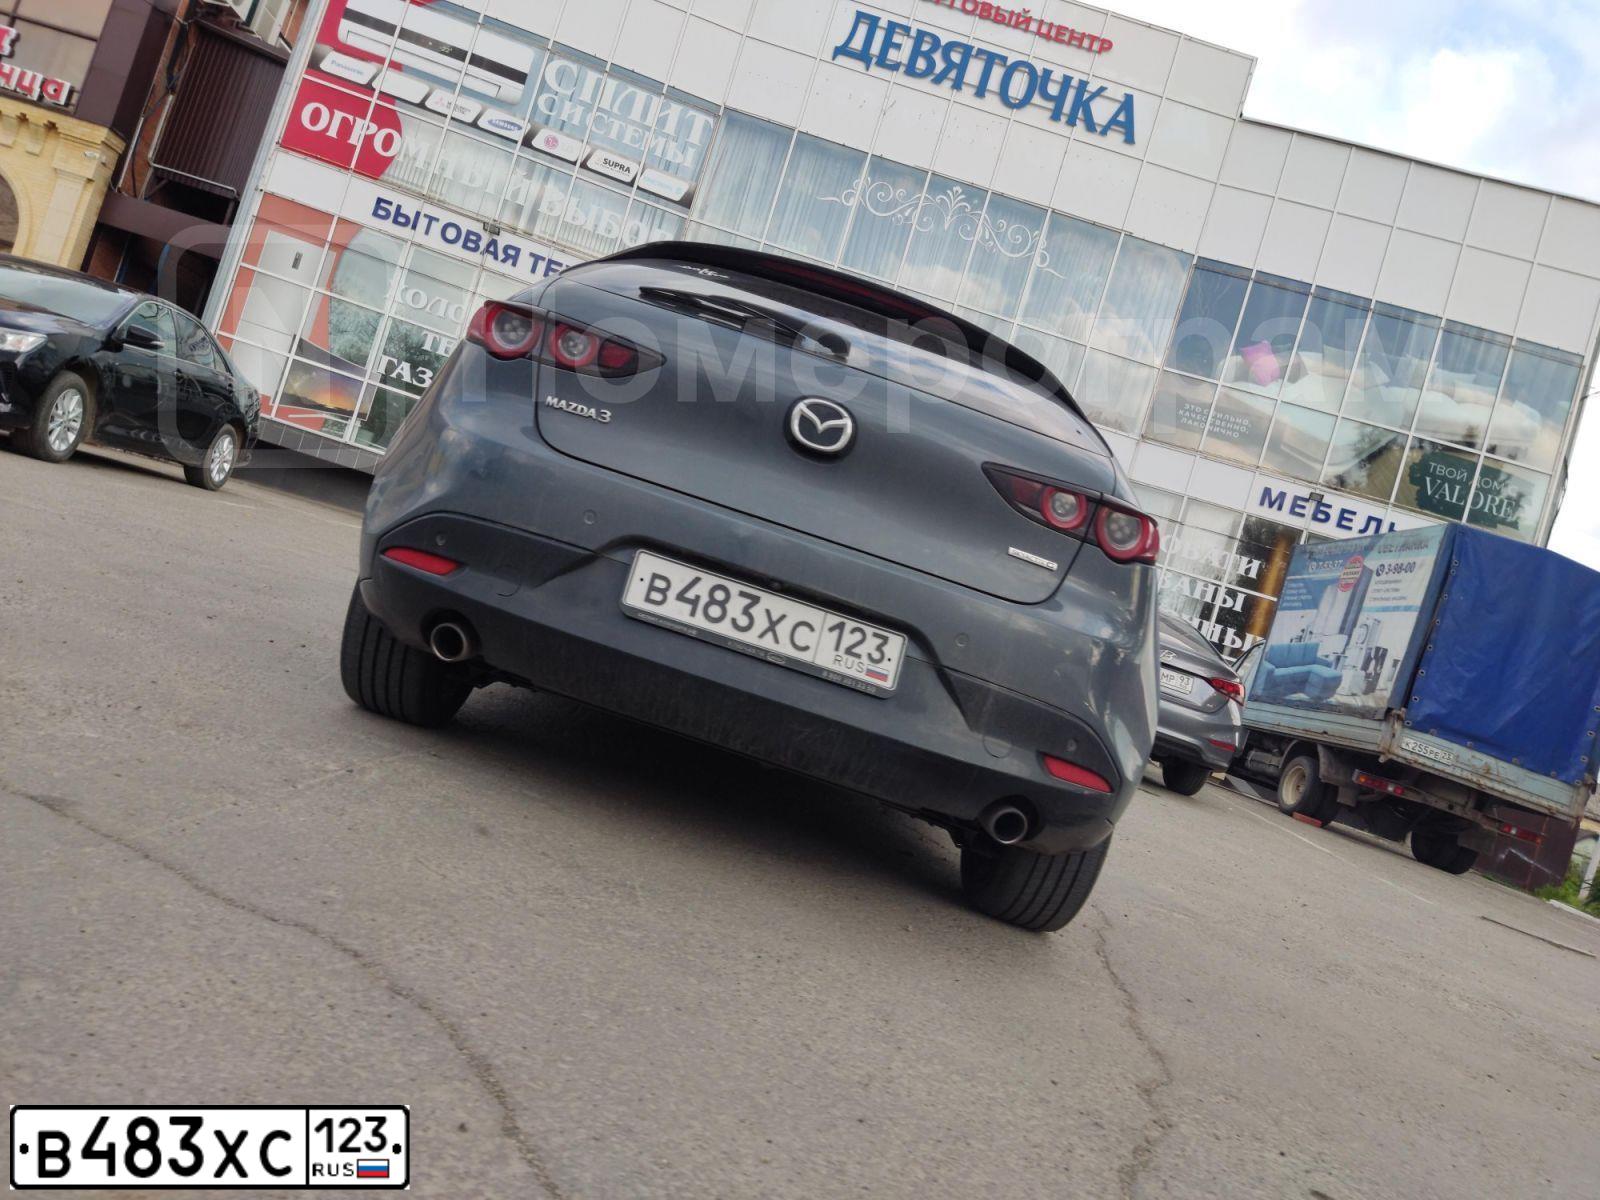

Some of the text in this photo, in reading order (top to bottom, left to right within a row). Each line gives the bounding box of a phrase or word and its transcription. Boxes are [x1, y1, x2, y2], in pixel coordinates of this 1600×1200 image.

[1036, 18, 1114, 55] ЦЕНТР
[543, 57, 716, 147] СПЛИТ
[832, 9, 1137, 145] ДЕВЯТОЧКА
[300, 101, 528, 207] ОГРОМНЫЙ
[537, 92, 697, 170] СИСТЕМЫ
[602, 157, 632, 175] SUPRA
[371, 196, 572, 279] БЫТОВАЯ ТЕ
[375, 354, 434, 389] ГАЗ
[1422, 475, 1519, 523] VALORE
[1428, 460, 1469, 484] ТВОЙ
[1472, 472, 1505, 494] ДОМ
[643, 572, 816, 653] В483ХС
[828, 620, 891, 666] 123
[832, 654, 866, 674] RUS
